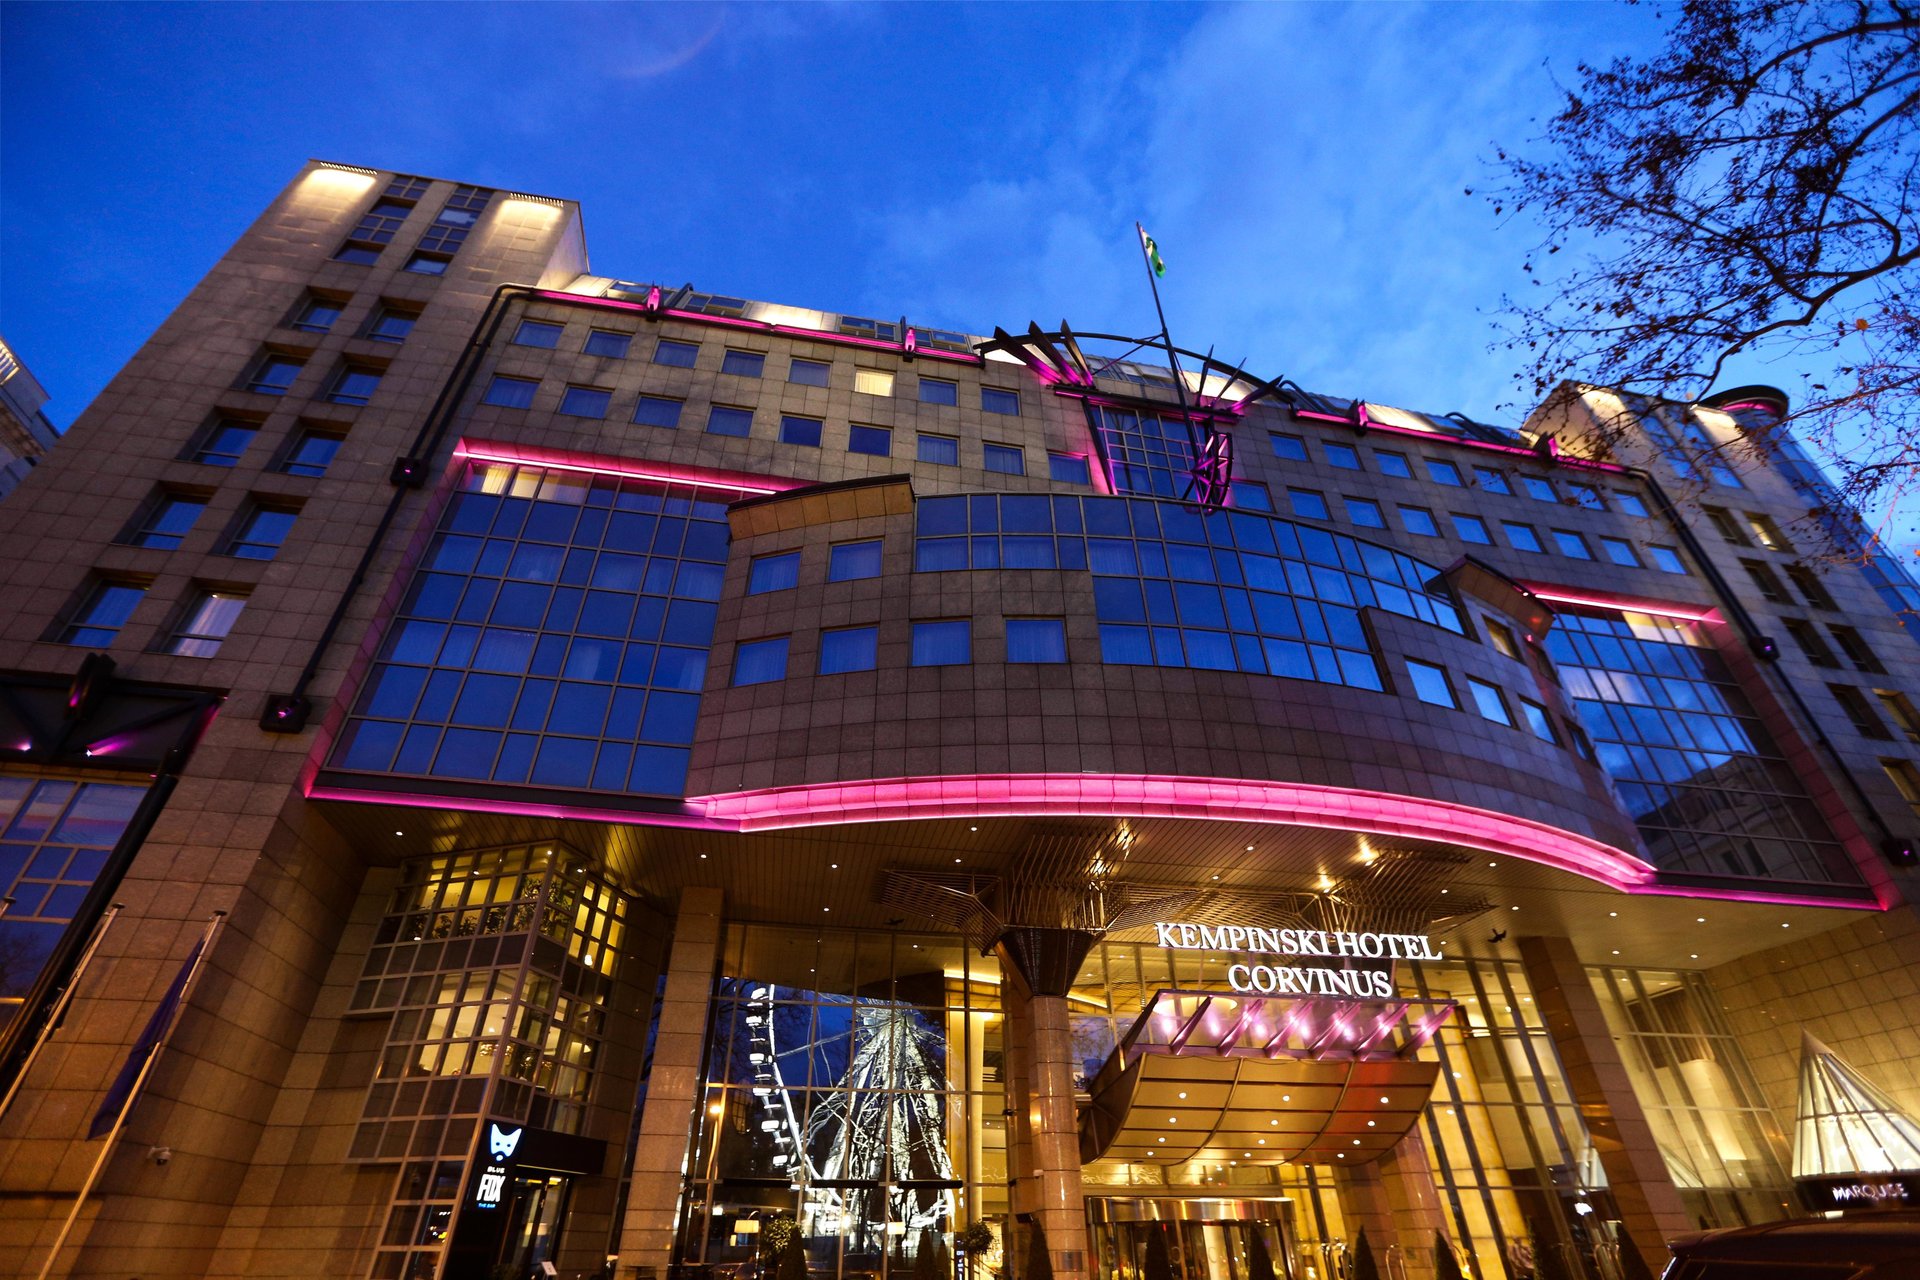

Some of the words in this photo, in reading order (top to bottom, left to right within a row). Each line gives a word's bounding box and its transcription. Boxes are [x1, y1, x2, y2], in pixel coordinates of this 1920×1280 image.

[1155, 922, 1334, 957] KEMPINSKI
[1335, 931, 1443, 960] HOTEL
[1228, 964, 1393, 997] CORVINUS
[476, 1174, 506, 1202] FOX
